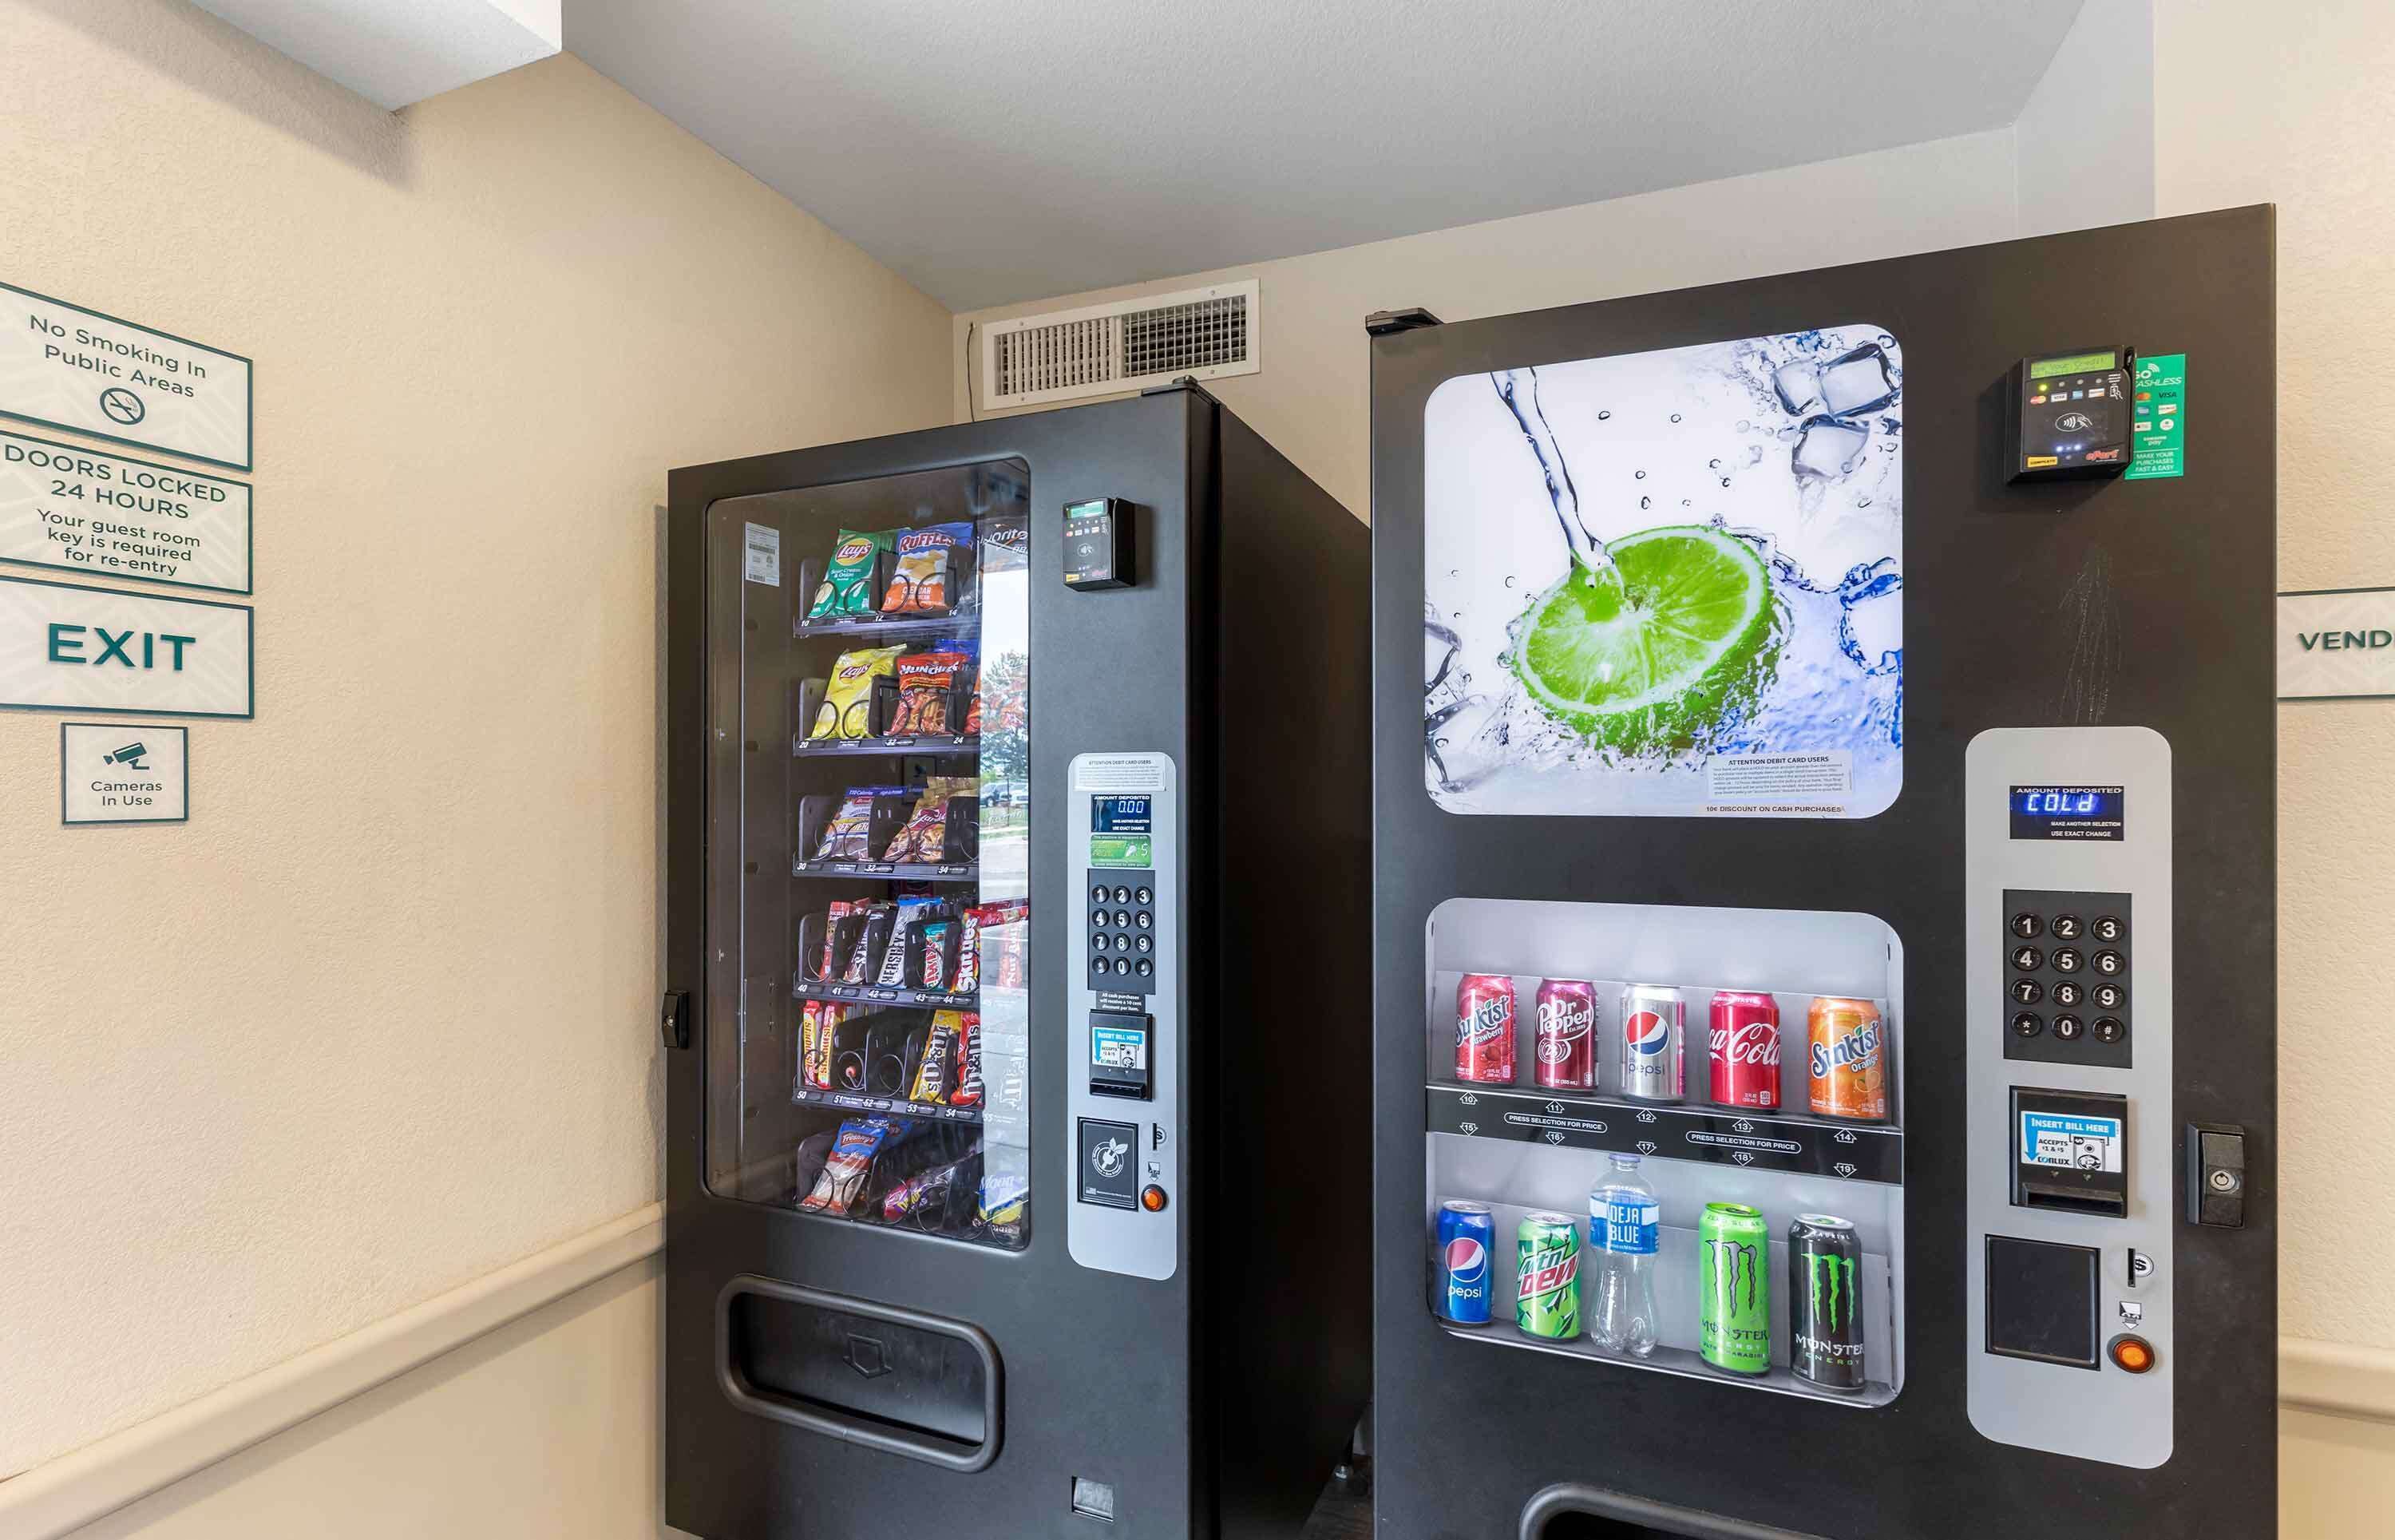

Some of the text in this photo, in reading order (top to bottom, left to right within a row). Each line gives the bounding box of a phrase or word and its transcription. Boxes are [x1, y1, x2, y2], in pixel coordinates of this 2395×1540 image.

[30, 315, 206, 378] No Smoking In
[45, 345, 195, 398] Public Areas
[5, 444, 226, 502] DOORS LOCKED
[51, 481, 189, 519] 24 HOURS
[37, 509, 200, 548] Your guest room
[48, 527, 192, 562] key is required
[901, 533, 955, 552] RUFFLES
[65, 548, 178, 576] for re-entry
[49, 623, 196, 671] EXIT
[91, 781, 163, 792] Cameras
[102, 795, 152, 806] In Use
[938, 865, 948, 874] 34
[1118, 889, 1125, 901] 2
[1139, 890, 1146, 902] 3
[1096, 912, 1146, 926] 4 5 6
[2022, 918, 2116, 937] 1 2 3
[1097, 936, 1146, 950] 7 8 9
[1118, 960, 1124, 972] 0
[2020, 951, 2115, 972] 4 5 6
[2021, 985, 2115, 1005] 7 8 9
[1553, 999, 1577, 1017] Dr
[1537, 1003, 1590, 1035] Pepper
[2060, 1020, 2072, 1035] 0
[1811, 1021, 1879, 1079] Sunkist
[1629, 1063, 1665, 1076] pepsi
[1851, 1054, 1879, 1073] Orange
[1531, 1117, 1566, 1126] SELECTION
[2031, 1118, 2109, 1133] INSERT BILL HERE
[1716, 1136, 1756, 1146] SELECTION
[1611, 1205, 1639, 1224] DEJA
[1611, 1225, 1639, 1244] BLUE
[1448, 1285, 1483, 1300] pepsi
[1796, 1334, 1864, 1356] MONSTER
